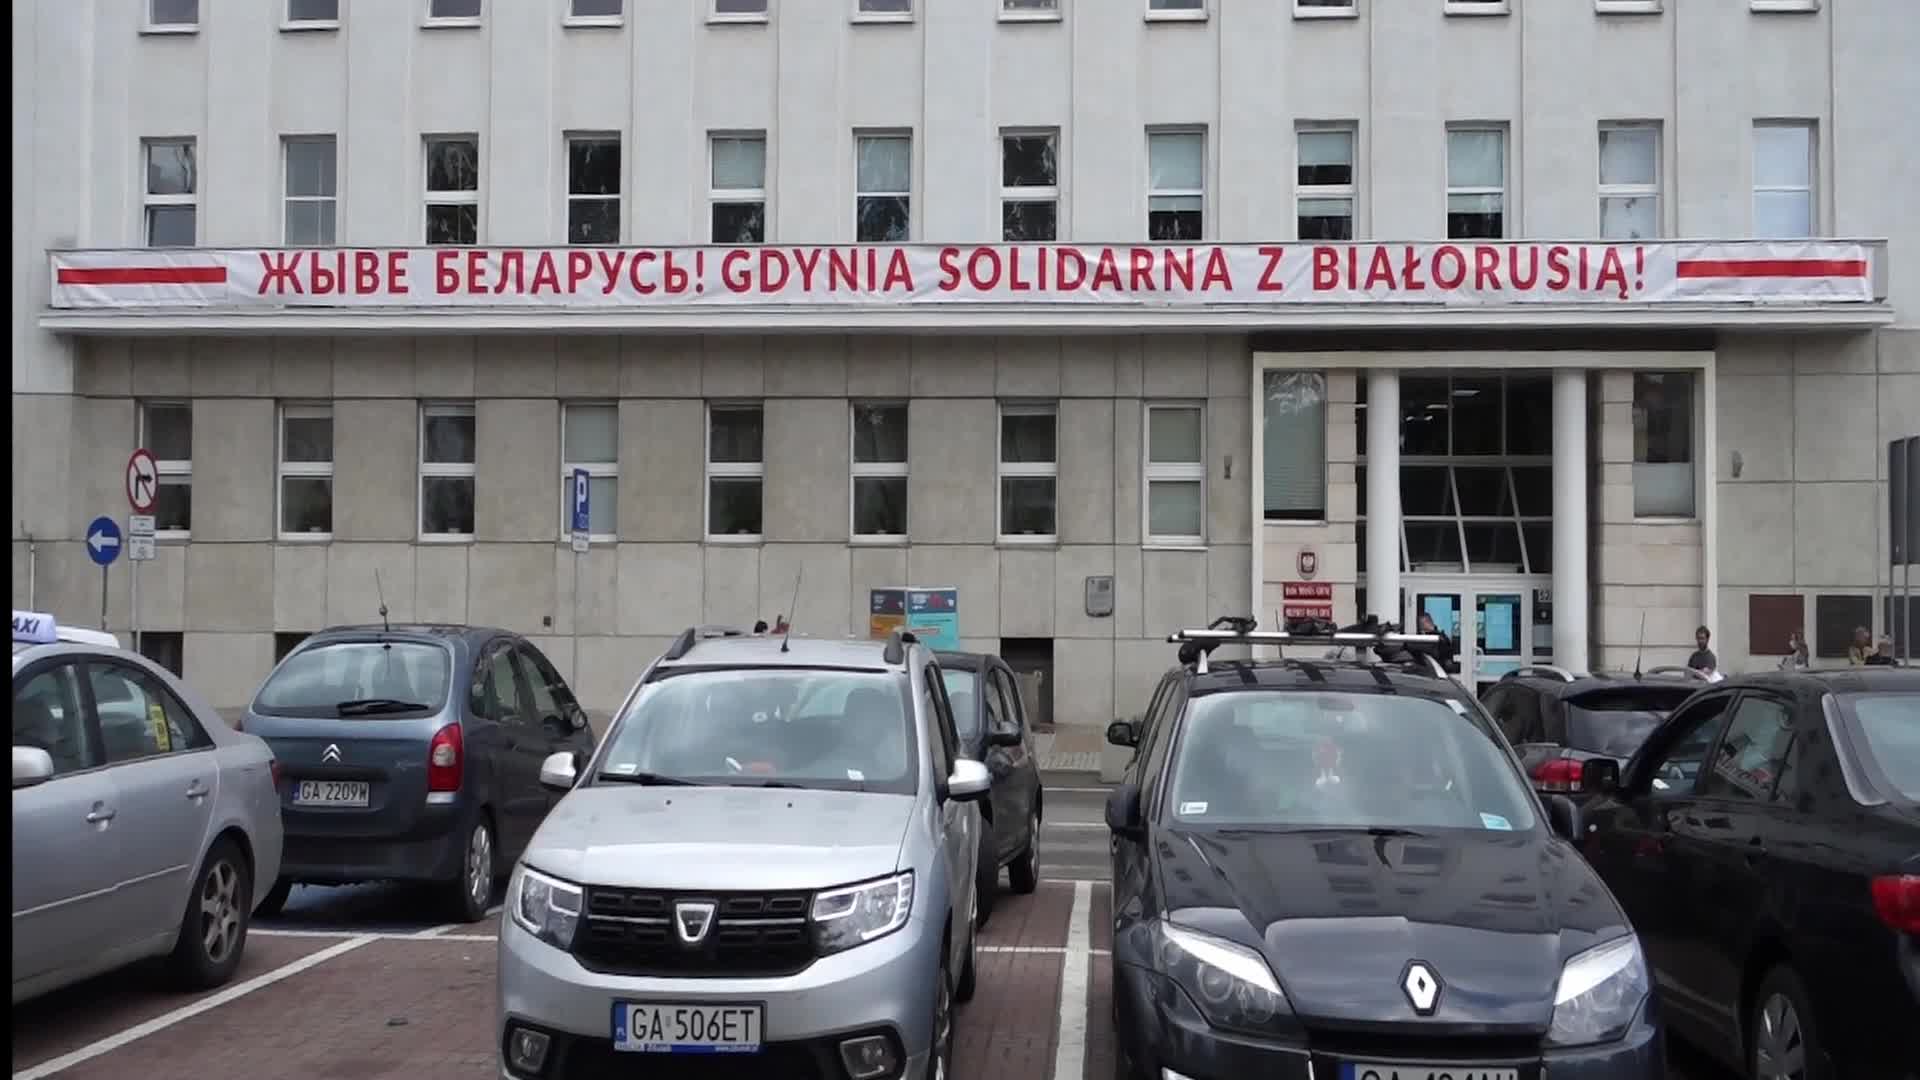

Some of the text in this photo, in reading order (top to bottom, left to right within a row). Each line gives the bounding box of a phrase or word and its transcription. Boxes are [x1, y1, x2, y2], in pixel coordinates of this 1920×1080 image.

[258, 244, 1645, 299] ЖЫВЕ БЕЛАРУСЬ! GDYNIA SOLIDARNA Z BIAŁORUSIĄ!
[575, 474, 588, 513] P
[302, 783, 321, 801] GA
[632, 1008, 754, 1042] GA 506ET
